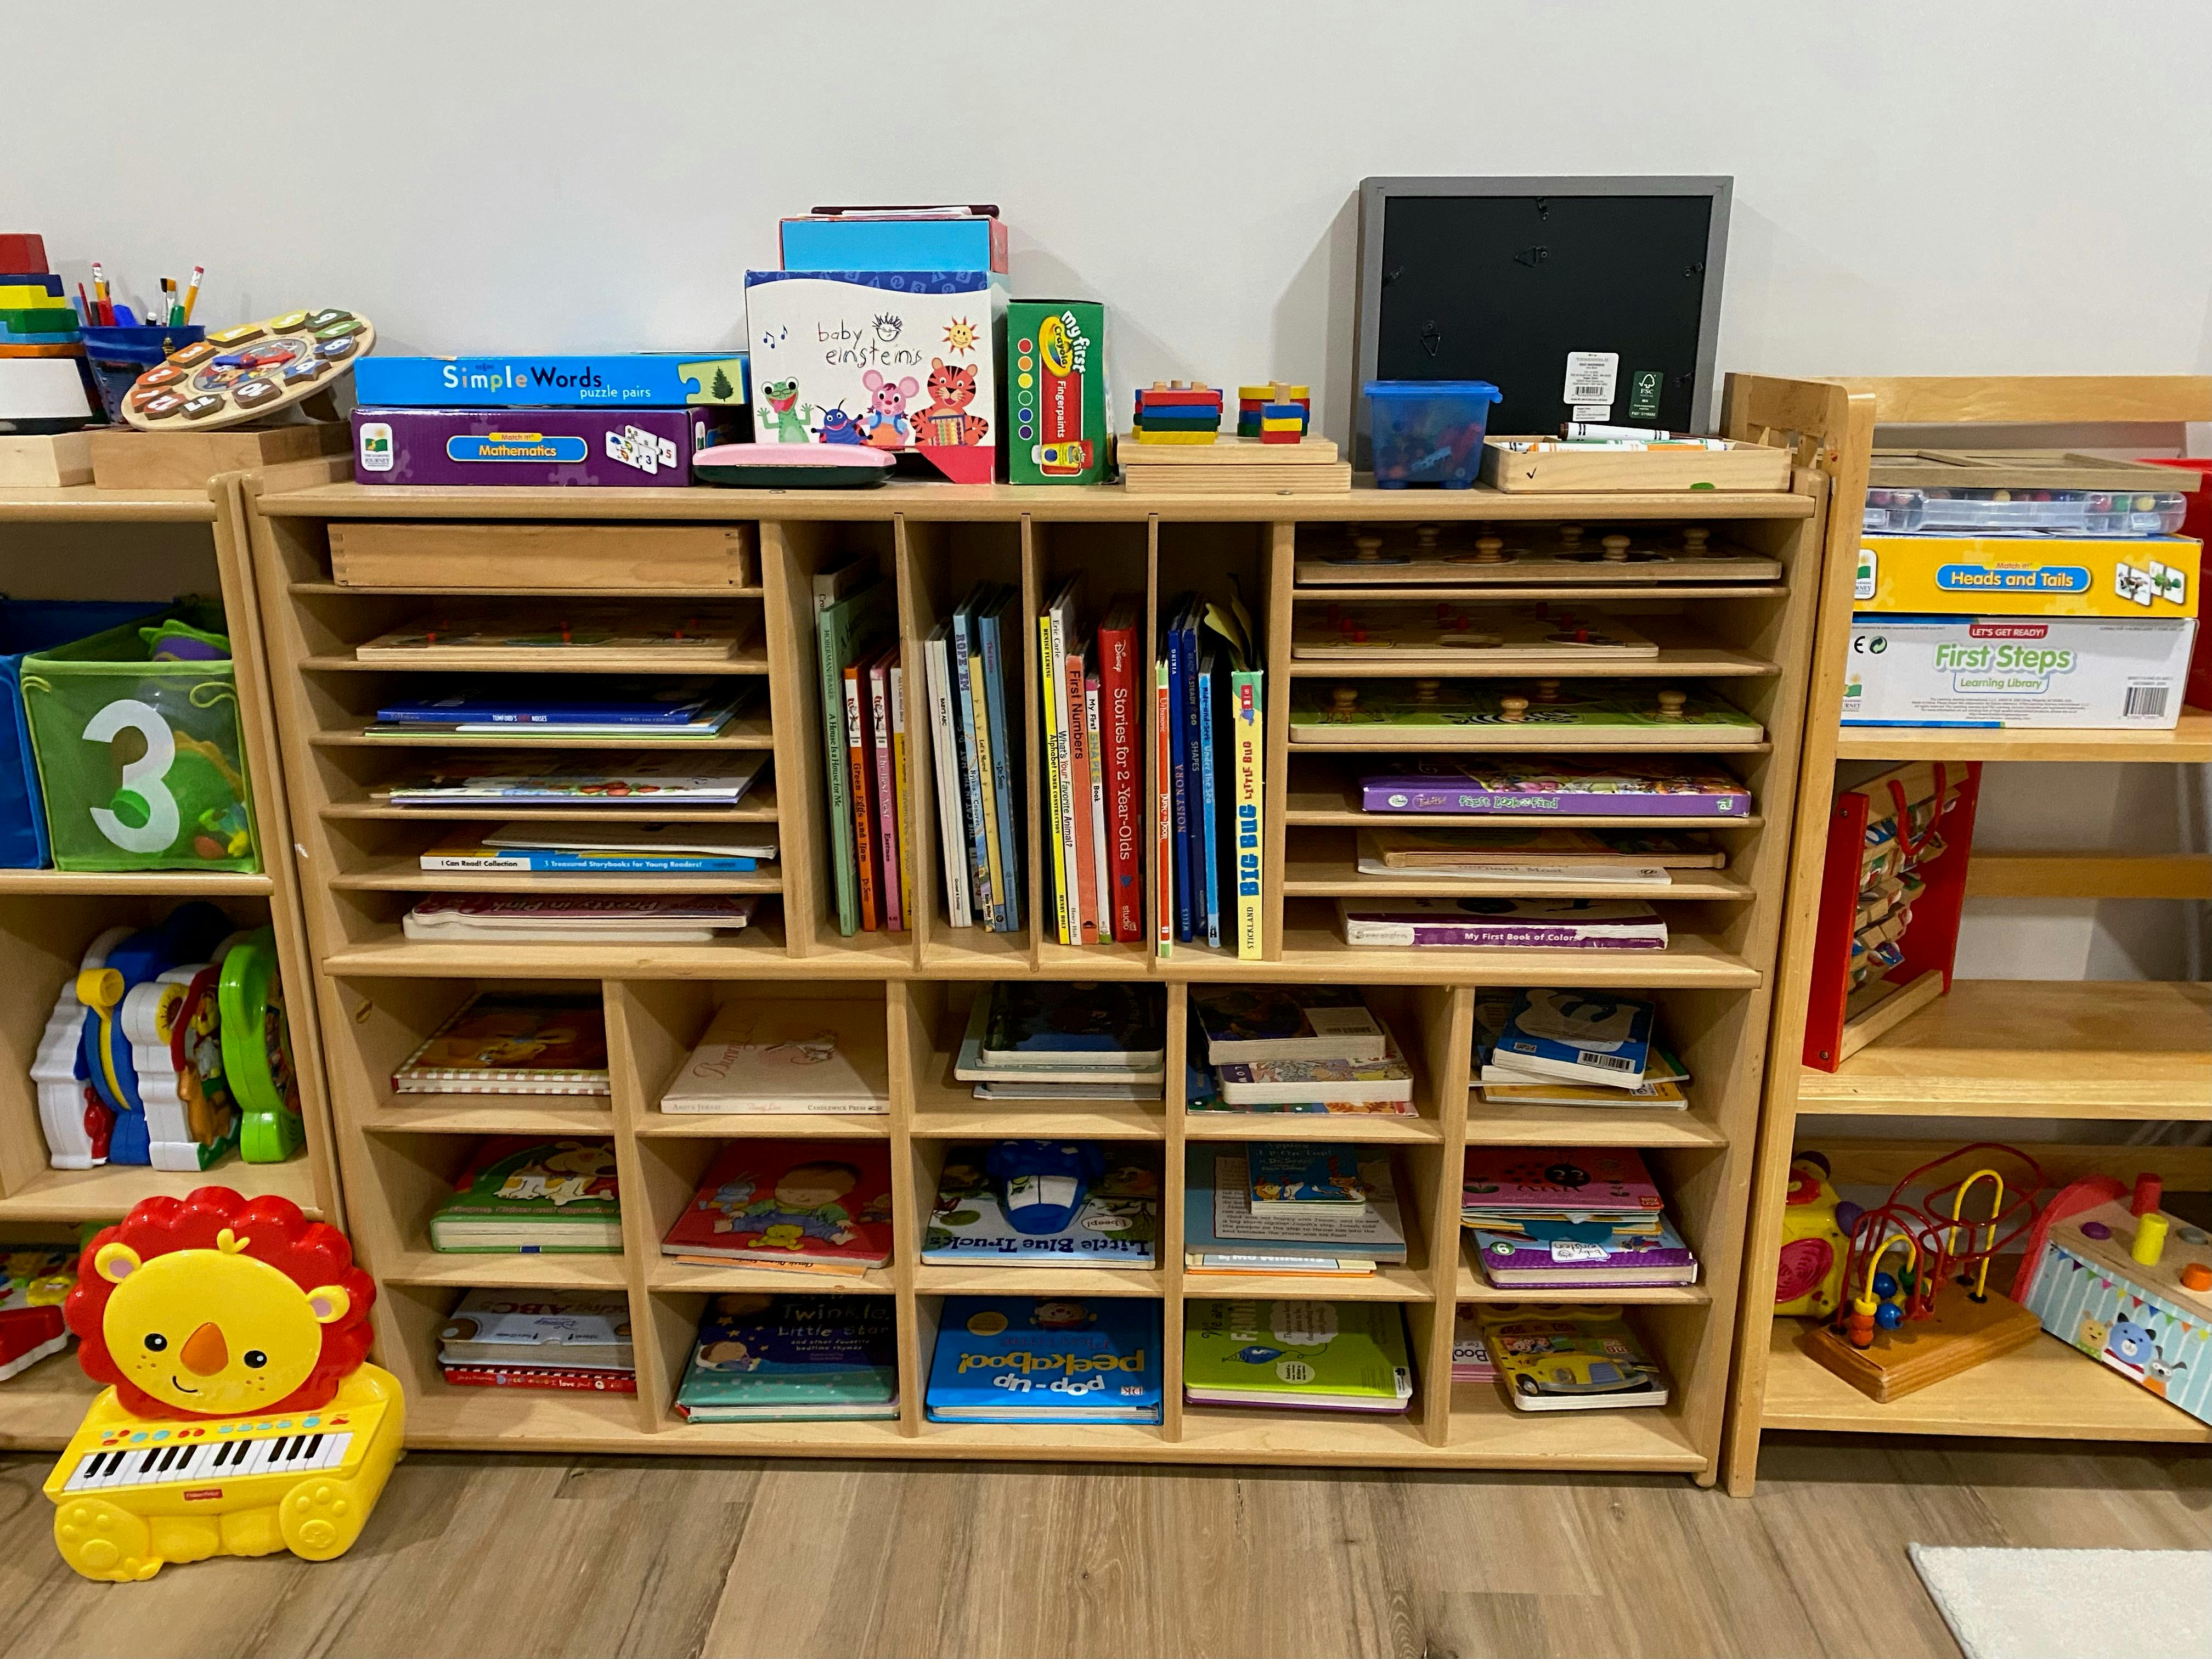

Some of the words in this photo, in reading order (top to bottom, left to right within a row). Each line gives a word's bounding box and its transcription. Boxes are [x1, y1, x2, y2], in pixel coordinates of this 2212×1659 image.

[817, 318, 862, 349] baby
[1054, 325, 1069, 365] Crayola
[1062, 310, 1081, 336] my
[1073, 337, 1091, 374] first
[443, 364, 528, 393] Simple
[531, 366, 602, 388] Words
[580, 385, 618, 400] puzzle
[623, 385, 651, 400] pairs
[1055, 381, 1066, 438] Fingerpaints
[479, 444, 557, 457] Mathematics
[645, 455, 652, 465] 3
[665, 449, 672, 459] 5
[1951, 572, 2001, 585] Heads
[2006, 572, 2036, 586] and
[2041, 573, 2074, 587] Tails
[1972, 628, 1993, 636] LET'S
[1995, 628, 2012, 636] GET
[2013, 628, 2044, 637] READY!
[824, 630, 832, 672] HOBERMAN
[956, 634, 967, 665] ROPE
[1936, 644, 1991, 667] First
[1996, 645, 2072, 674] Steps
[960, 669, 970, 691] 'EM
[1069, 670, 1081, 700] First
[1961, 678, 2004, 690] Learning
[2007, 679, 2042, 690] Library
[1089, 698, 1096, 711] My
[1114, 688, 1128, 739] Stories
[1202, 687, 1211, 741] Hide-and-Seek
[1071, 702, 1083, 759] Numbers
[1190, 713, 1197, 726] GO
[1048, 734, 1058, 770] Alphabet
[1058, 730, 1067, 758] What's
[1116, 741, 1130, 765] for
[830, 721, 838, 742] House
[834, 795, 840, 808] Me
[1088, 733, 1101, 783] SHAPES
[1191, 741, 1200, 772] SHAPES
[82, 699, 180, 854] 3
[853, 763, 861, 791] Green
[880, 770, 889, 794] Best
[1175, 764, 1184, 796] NORA
[1244, 766, 1254, 799] LITTLE
[855, 795, 866, 817] Eggs
[882, 797, 890, 818] Nest
[965, 791, 973, 802] IN
[1062, 781, 1070, 814] Favorite
[1459, 796, 1491, 808] First
[1493, 796, 1517, 809] Look
[1531, 797, 1559, 809] Find
[966, 803, 974, 821] CAT
[1177, 799, 1187, 833] NOISY
[1064, 816, 1073, 847] Animal?
[1239, 804, 1257, 848] BUG
[646, 861, 668, 869] Young
[1240, 854, 1259, 896] BIG
[490, 900, 544, 912] Pink
[1087, 1220, 1118, 1228] beep!
[1022, 1238, 1074, 1252] Blue
[1081, 1239, 1150, 1256] Little
[1496, 1243, 1510, 1255] 6
[1578, 1247, 1602, 1256] baby
[491, 1302, 572, 1314] ABC
[533, 1319, 576, 1330] Disney
[777, 1324, 833, 1338] Little
[843, 1324, 889, 1335] Star
[958, 1349, 1145, 1376] peekaboo!
[1121, 1387, 1144, 1396] DK
